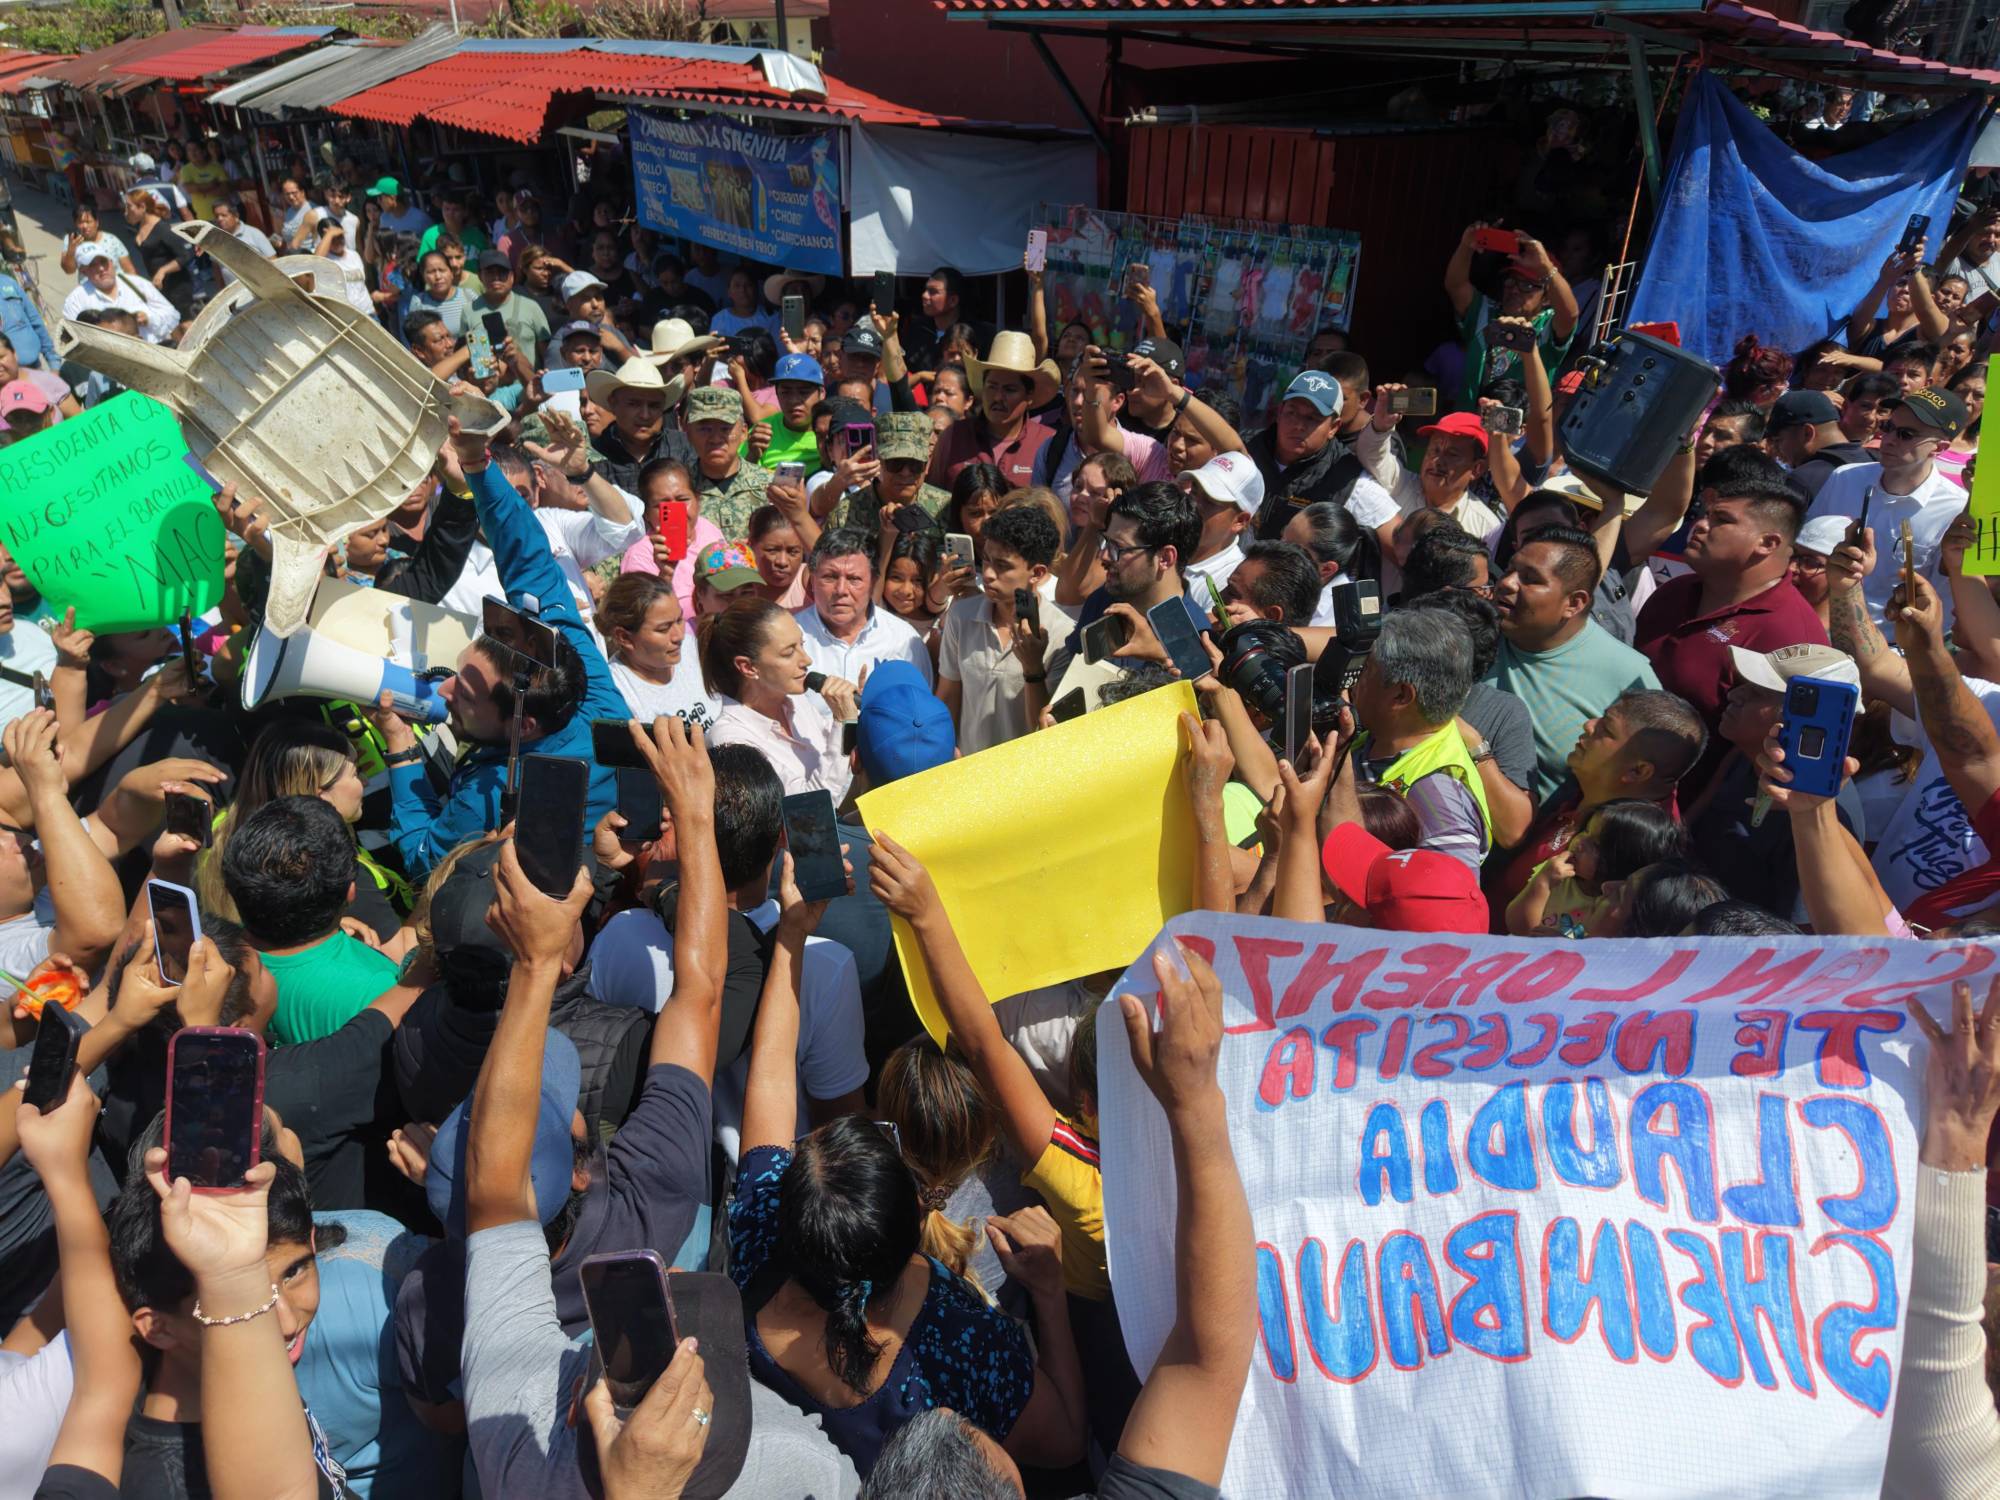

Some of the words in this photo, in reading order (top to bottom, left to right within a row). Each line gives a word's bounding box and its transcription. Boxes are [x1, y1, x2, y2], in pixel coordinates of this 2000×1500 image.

[702, 125, 722, 150] LA
[32, 539, 103, 585] PARA
[105, 516, 136, 551] EL
[128, 474, 202, 524] BACHILL
